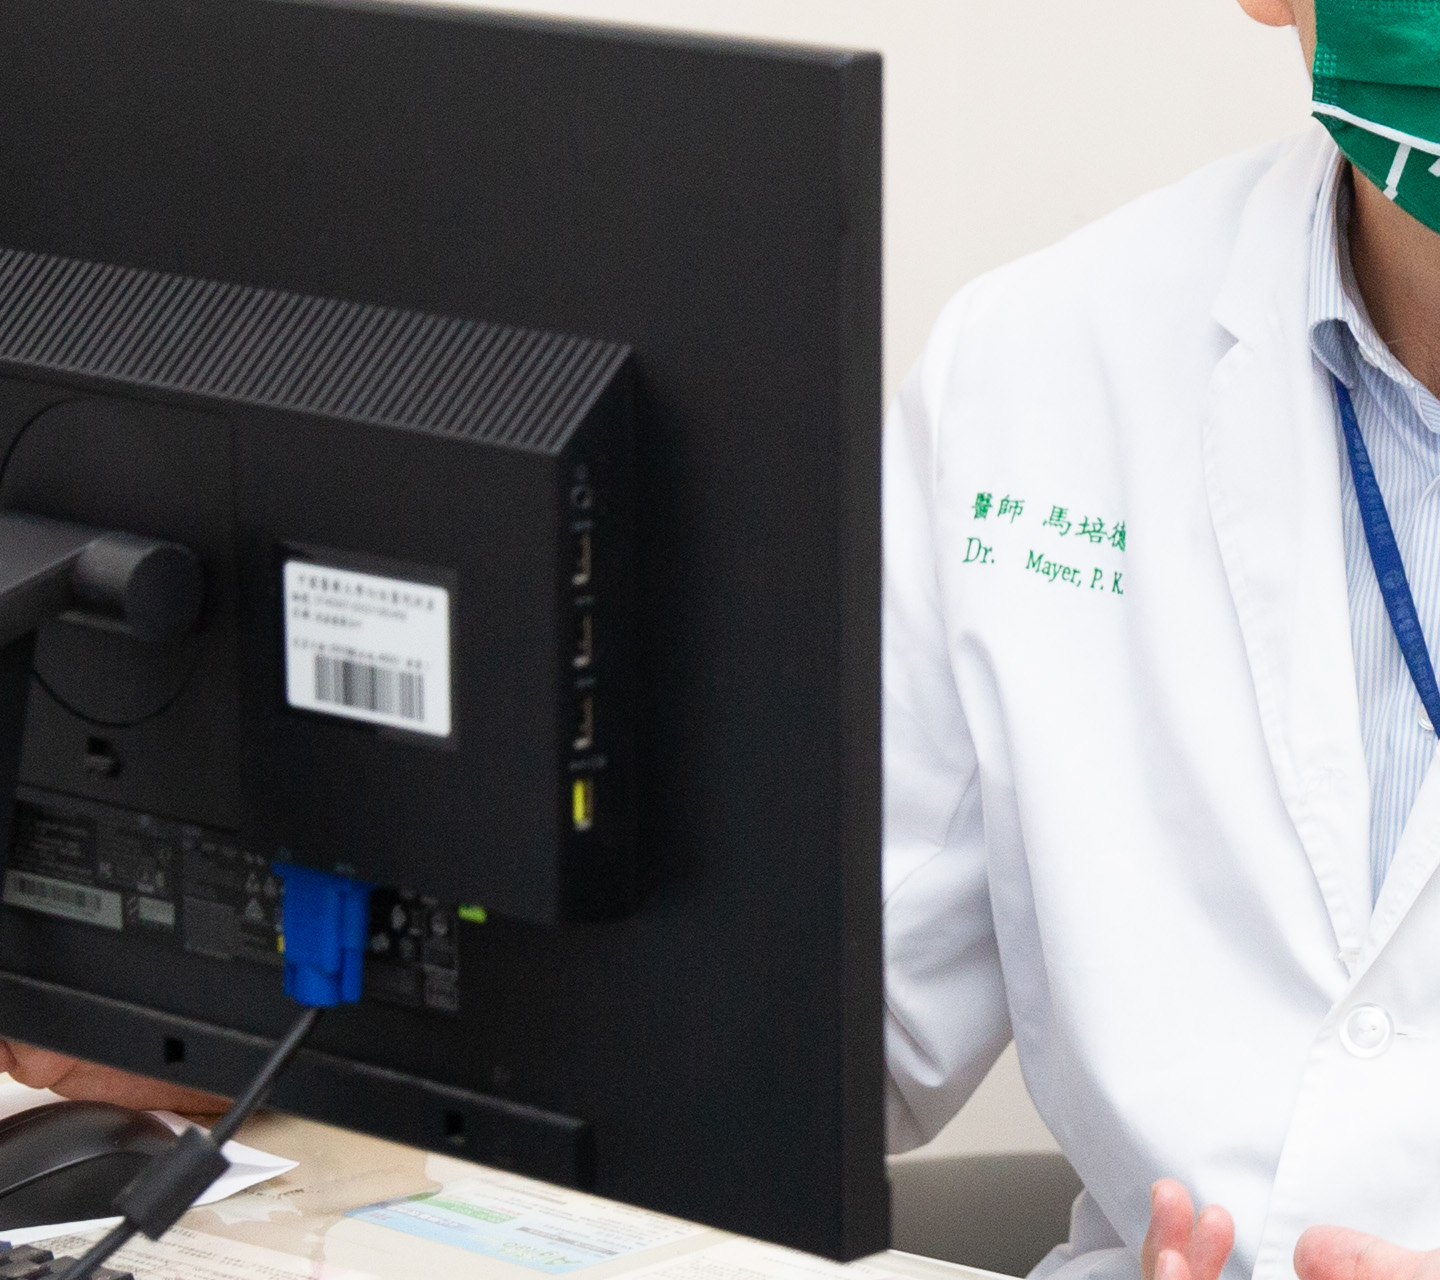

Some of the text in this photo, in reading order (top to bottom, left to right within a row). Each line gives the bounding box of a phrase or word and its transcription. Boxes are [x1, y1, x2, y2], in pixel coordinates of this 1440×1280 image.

[971, 492, 1025, 524] 醫師
[962, 537, 995, 564] Dr.
[1025, 549, 1082, 588] Mayer,
[1090, 567, 1104, 591] P.
